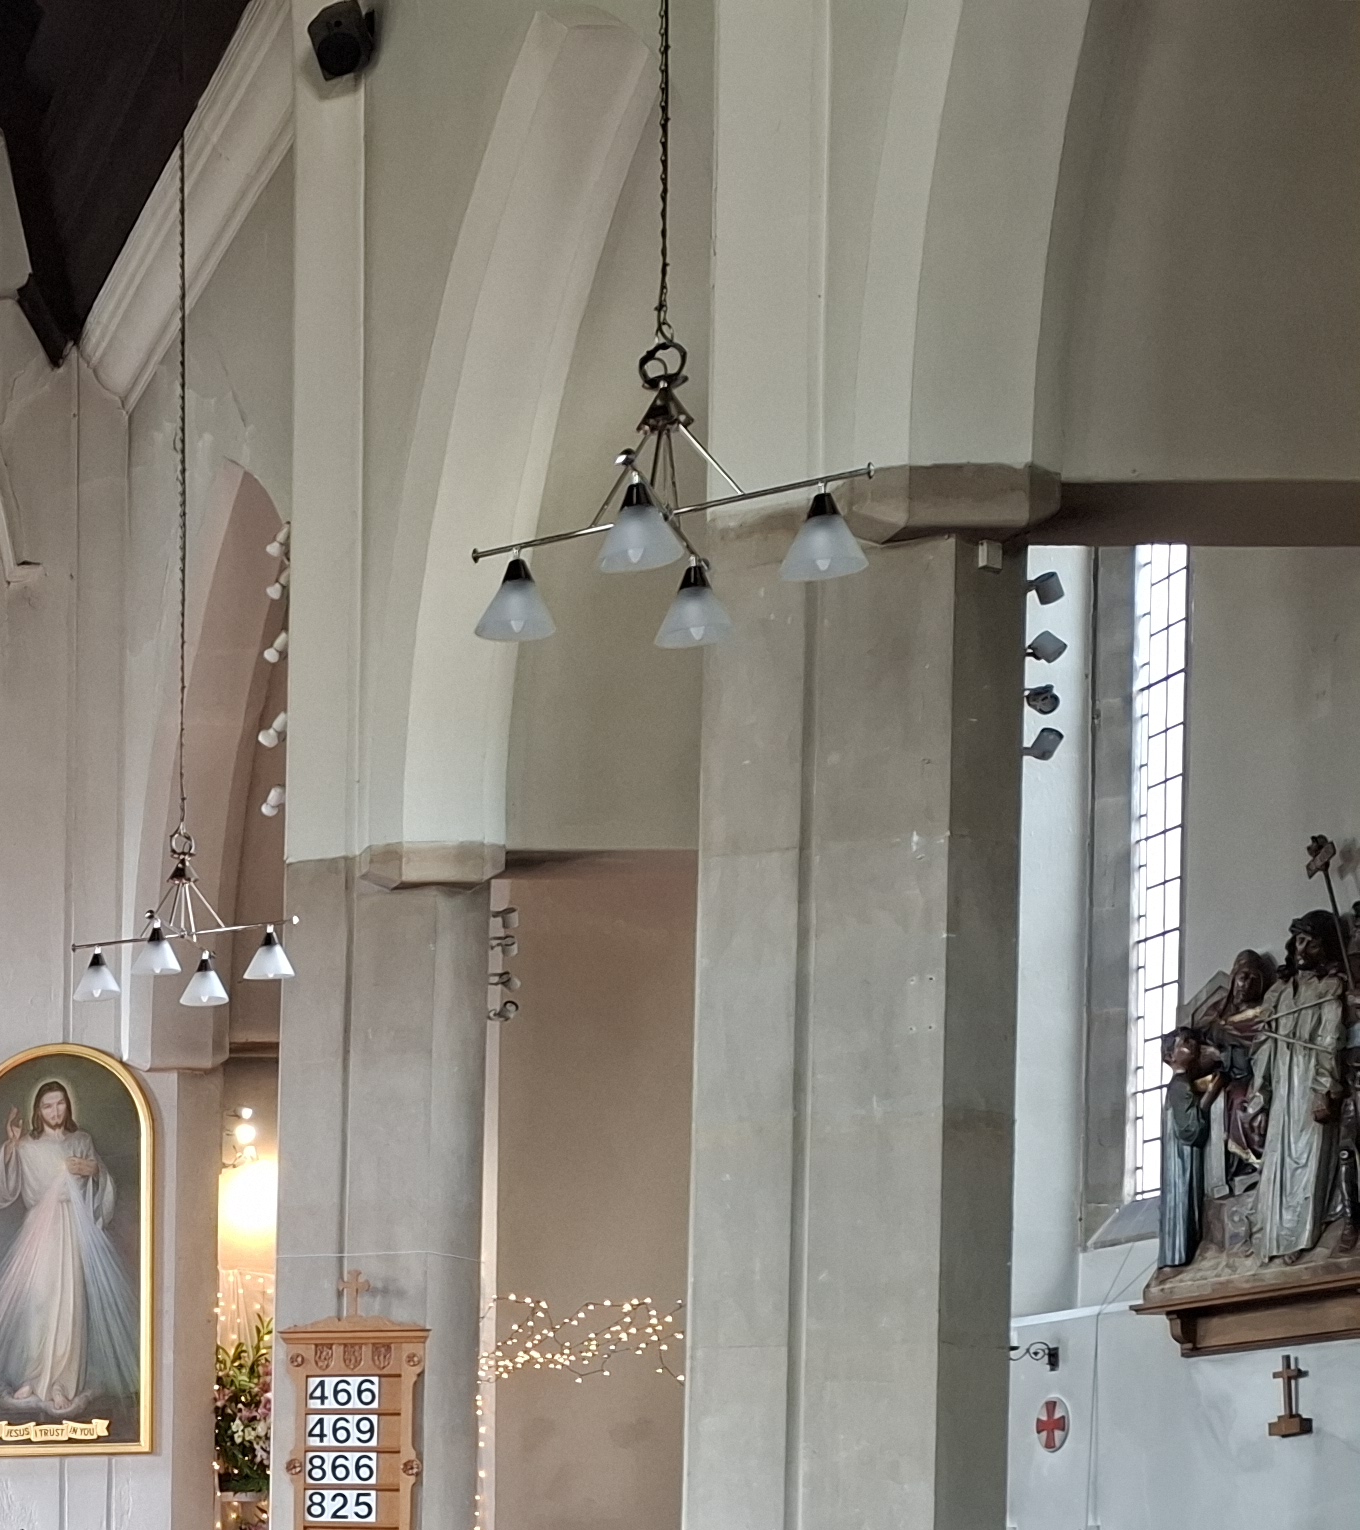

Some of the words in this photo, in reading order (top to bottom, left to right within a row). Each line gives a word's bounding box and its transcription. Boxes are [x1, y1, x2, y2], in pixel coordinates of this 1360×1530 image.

[308, 1378, 376, 1406] 466
[5, 1427, 30, 1438] JESUS
[34, 1428, 38, 1438] I
[40, 1428, 65, 1437] TRUST
[68, 1427, 77, 1436] IN
[79, 1427, 95, 1437] YOU
[307, 1416, 375, 1444] 469
[307, 1454, 374, 1482] 866
[306, 1491, 373, 1519] 825
